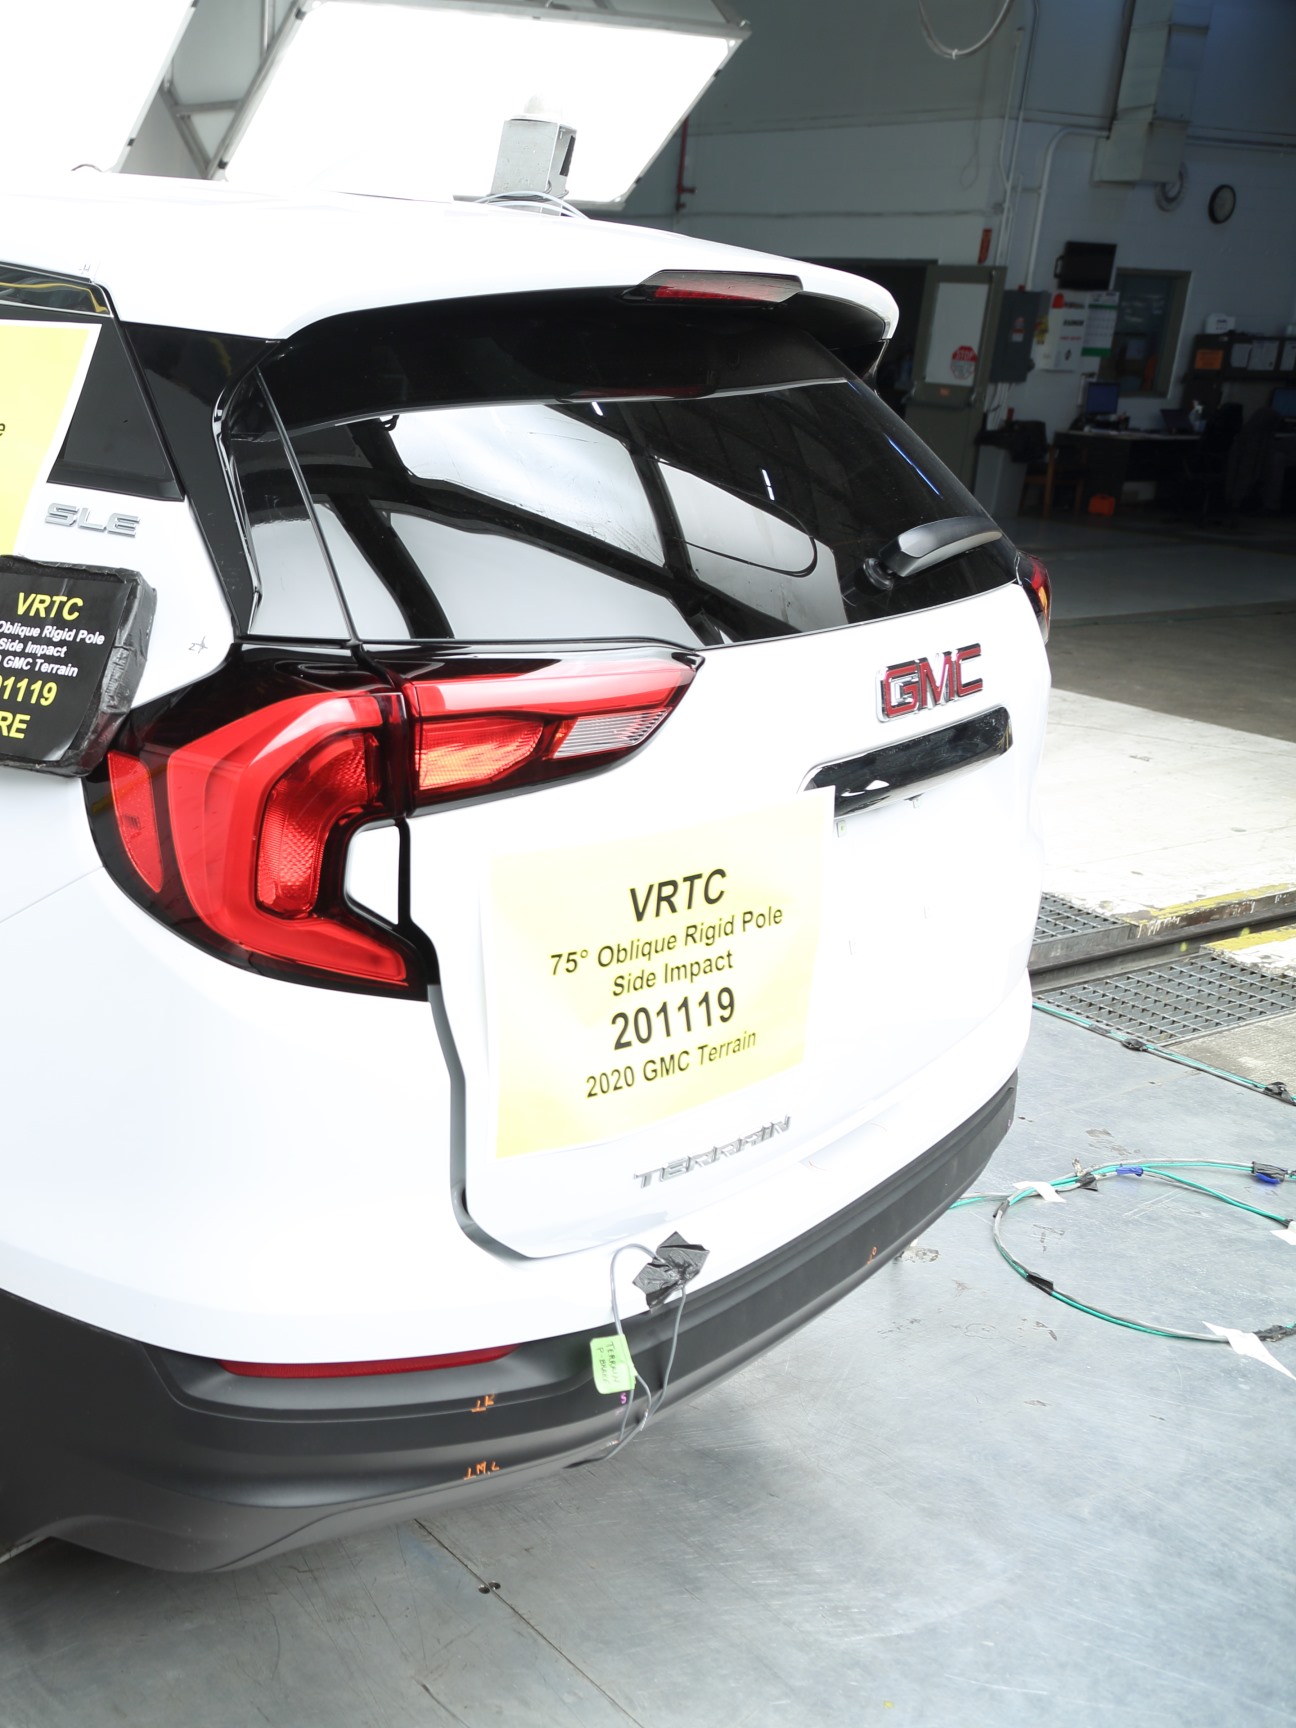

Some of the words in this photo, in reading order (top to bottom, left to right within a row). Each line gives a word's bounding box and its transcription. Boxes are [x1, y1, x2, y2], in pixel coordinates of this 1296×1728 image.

[44, 502, 141, 538] SLE
[17, 591, 84, 621] VRTC
[25, 640, 68, 658] Impact
[42, 625, 77, 643] Rigid
[75, 630, 106, 645] Pole
[3, 656, 33, 672] GMC
[34, 658, 79, 678] Terrain
[876, 642, 984, 723] GMC
[629, 868, 727, 922] VRTC
[597, 934, 678, 968] Oblique
[684, 914, 736, 947] Rigid
[742, 906, 784, 933] Pole
[612, 969, 657, 997] Side
[664, 950, 734, 983] Impact
[611, 986, 736, 1051] 201119
[586, 1065, 635, 1098] 2020
[643, 1050, 691, 1082] GMC
[697, 1030, 757, 1065] Terrain
[633, 1113, 792, 1189] TERRAIN
